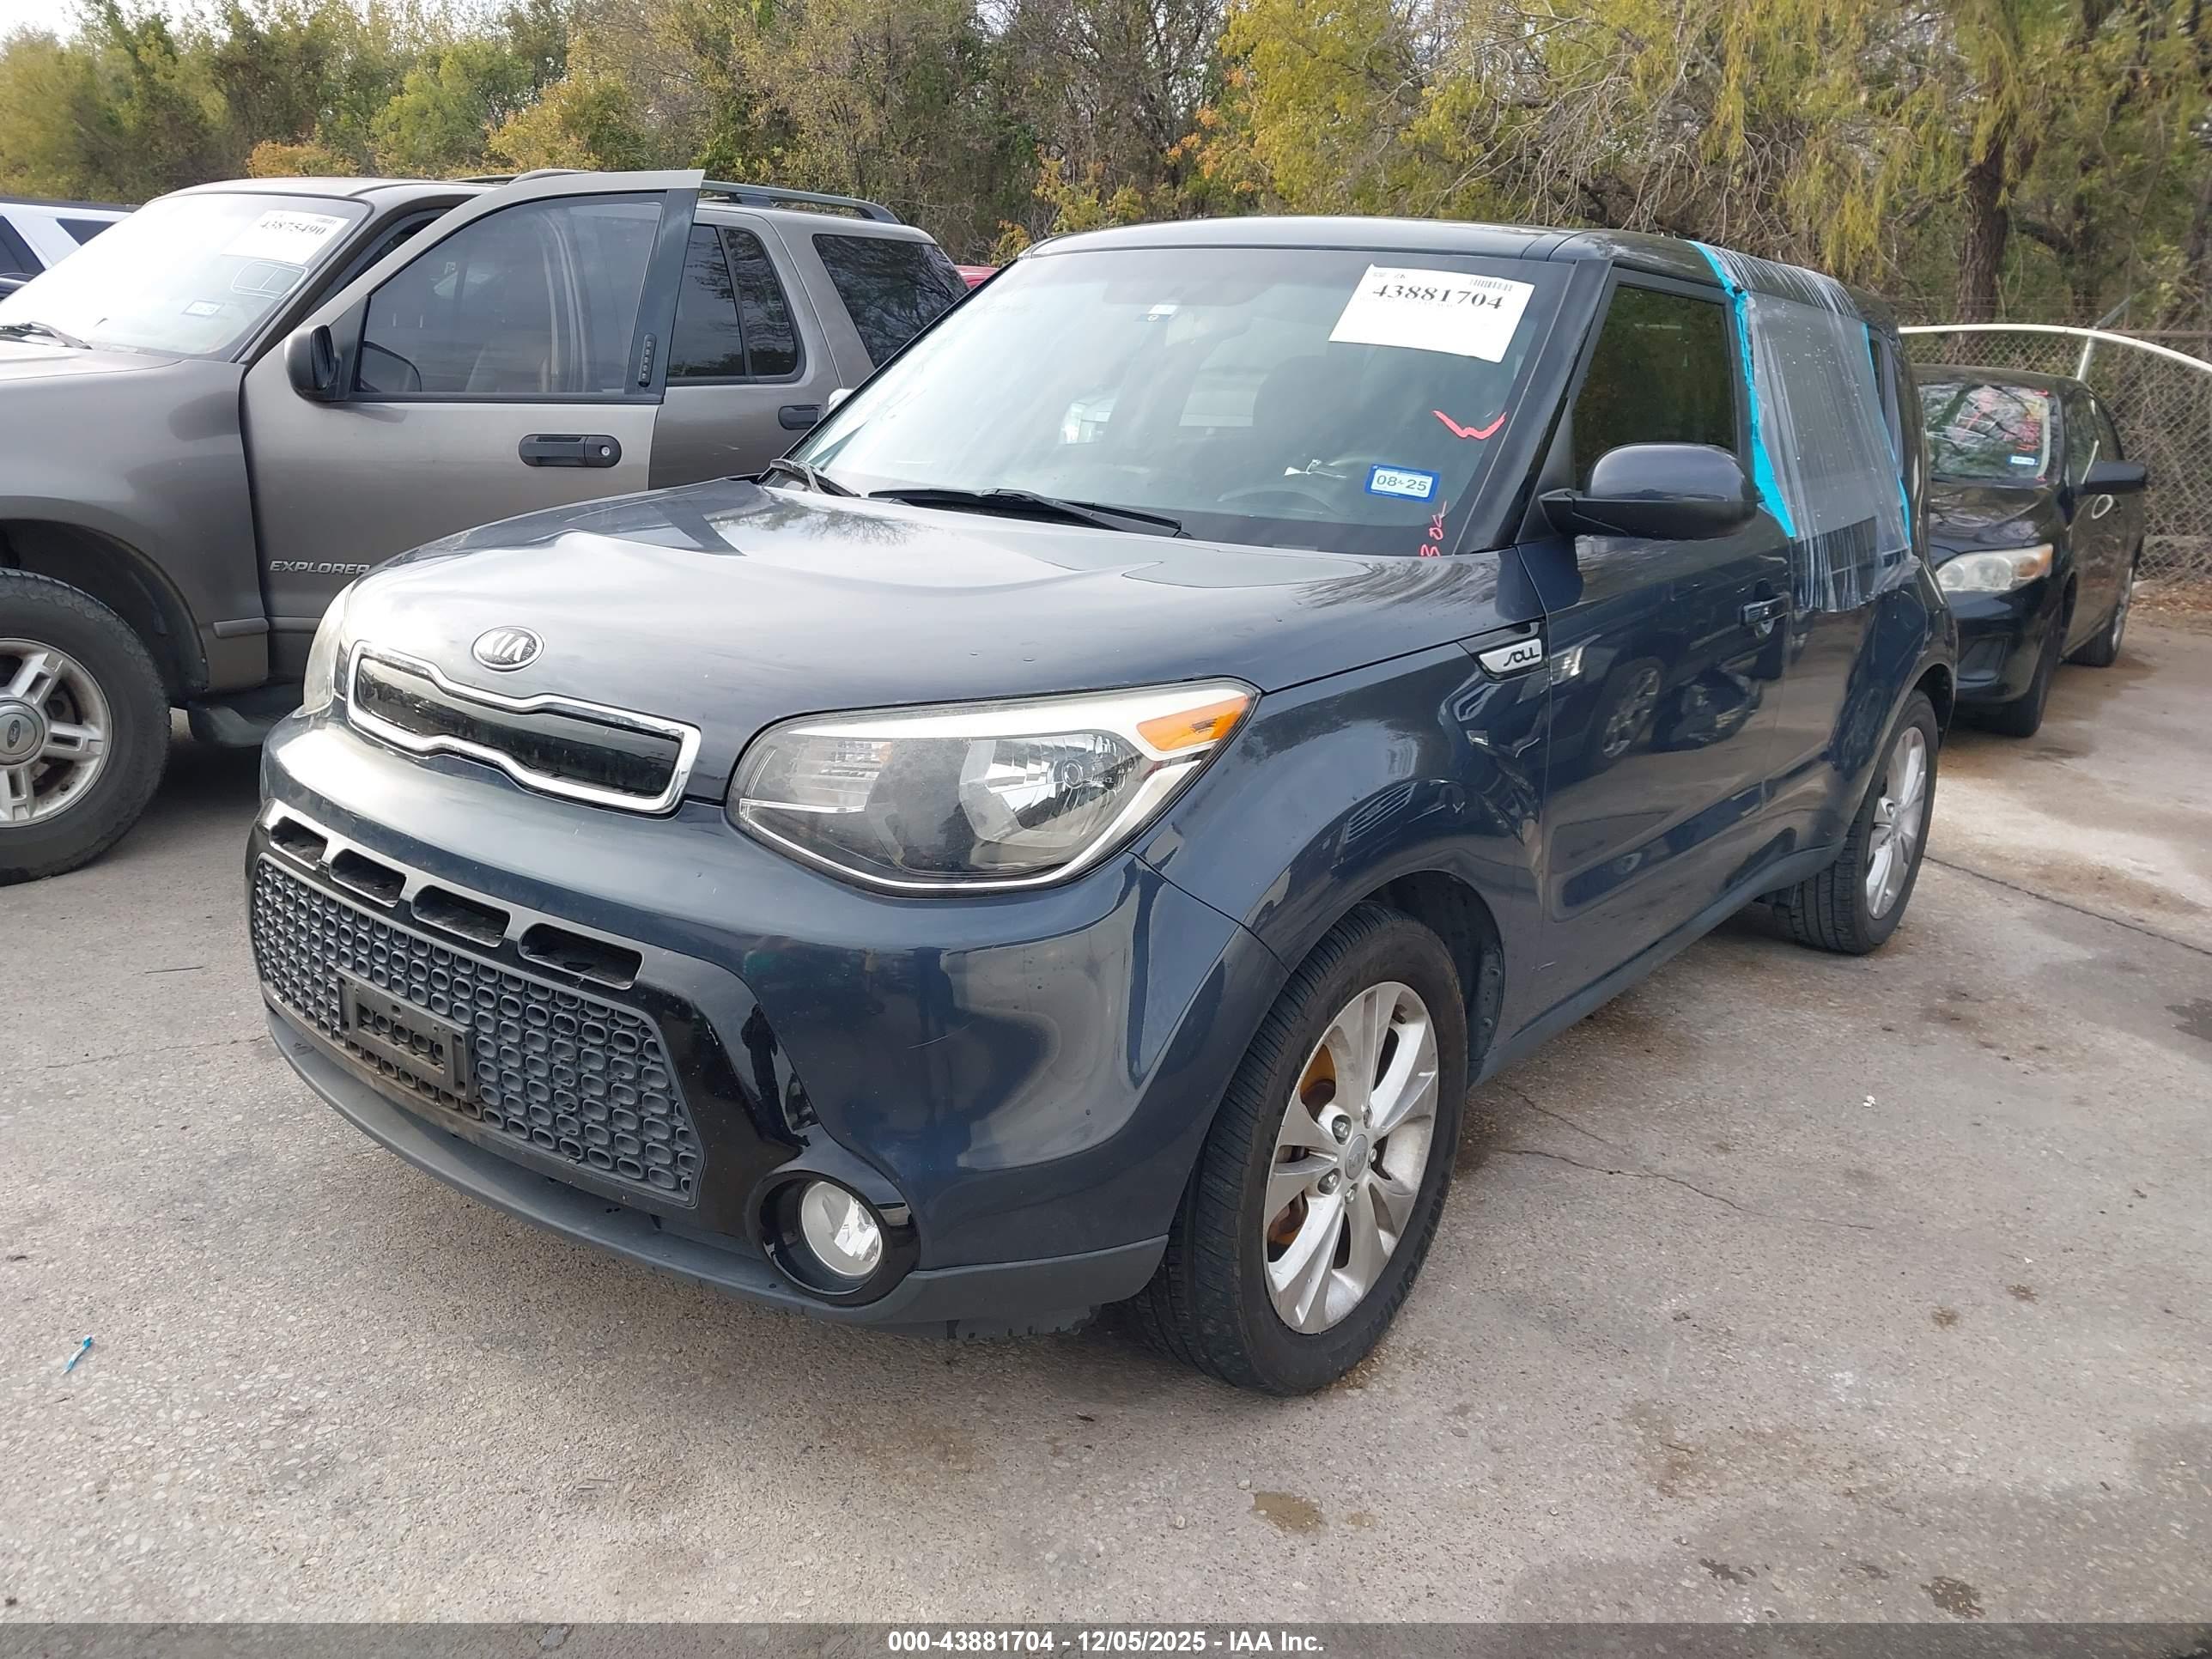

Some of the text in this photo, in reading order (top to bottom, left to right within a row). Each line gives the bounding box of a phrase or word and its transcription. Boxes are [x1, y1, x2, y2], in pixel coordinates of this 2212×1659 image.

[1372, 283, 1504, 310] 43881704
[1376, 474, 1428, 492] 08 25
